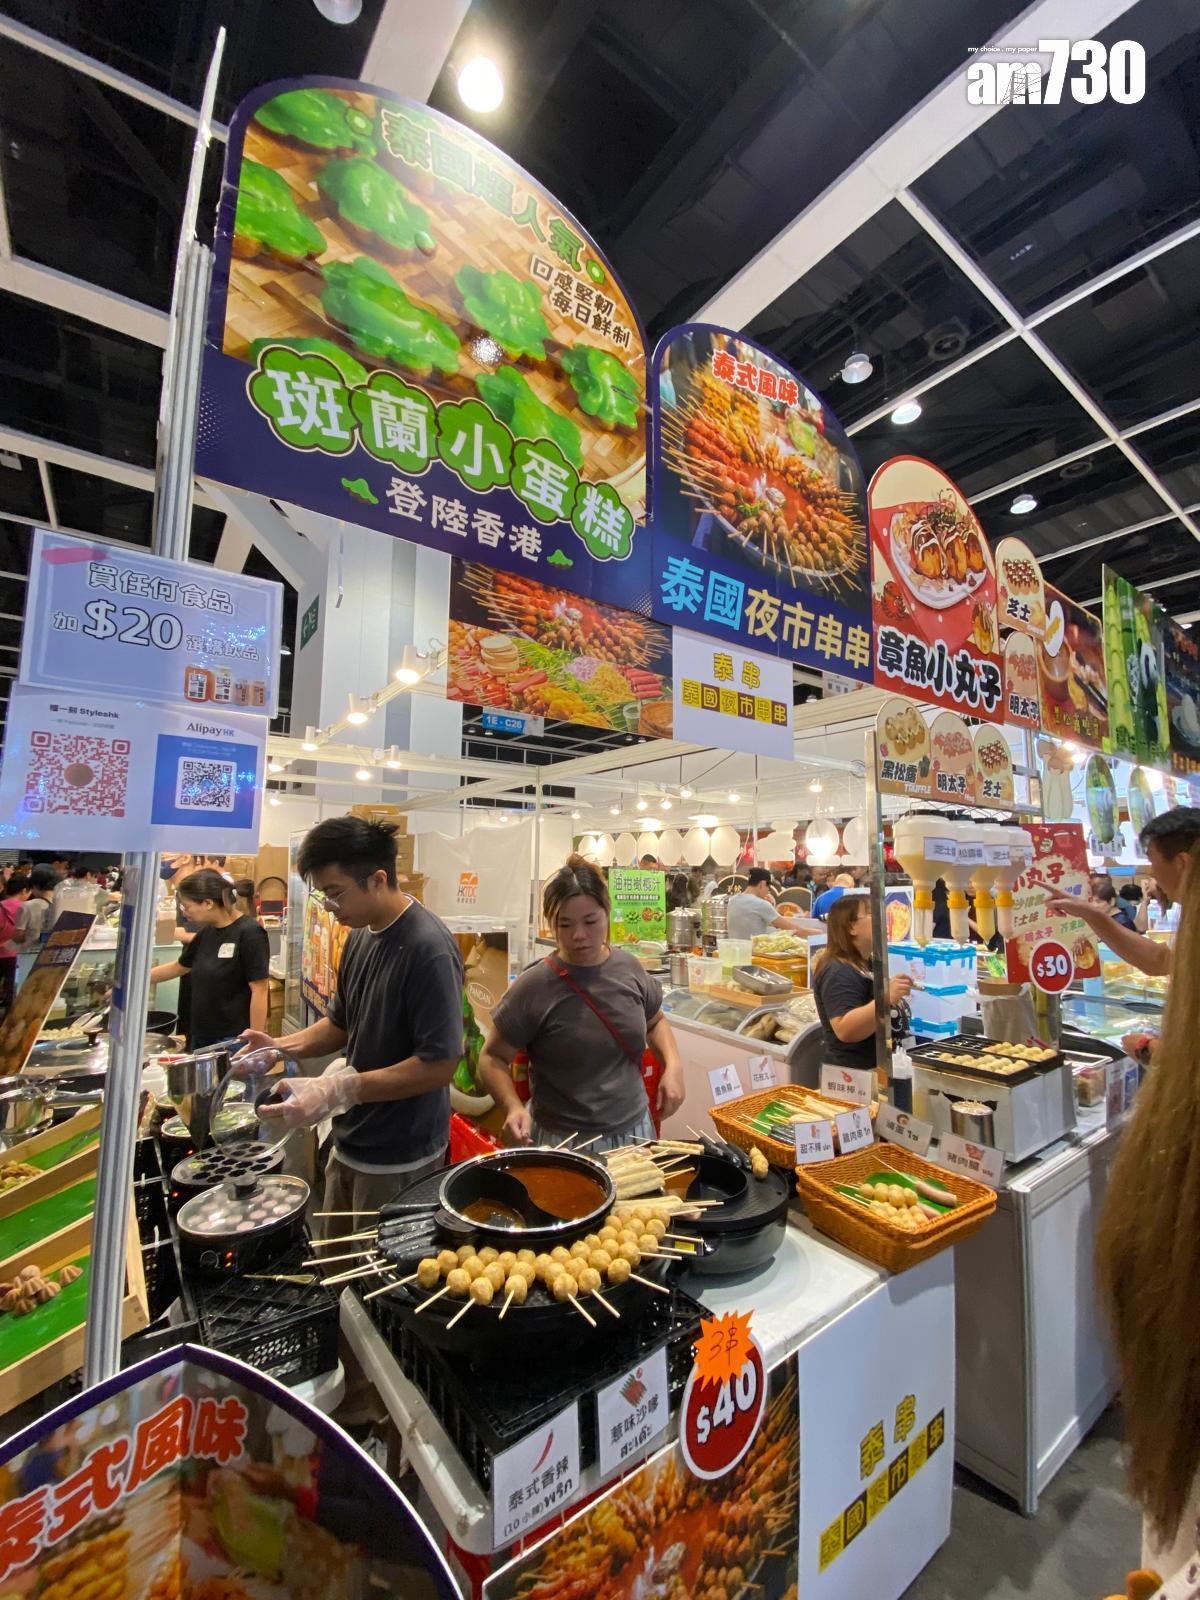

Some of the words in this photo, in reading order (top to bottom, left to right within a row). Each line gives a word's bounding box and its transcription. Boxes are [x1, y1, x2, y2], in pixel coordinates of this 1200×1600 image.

[552, 291, 631, 348] 每日鮮制
[711, 350, 799, 406] 泰式風味
[267, 369, 626, 551] 斑蘭小蛋糕
[386, 477, 543, 562] 登陸香港
[88, 563, 234, 615] 買任何食品
[660, 555, 871, 669] 泰國夜市串串
[1007, 598, 1031, 622] 芝士
[53, 611, 79, 632] 加
[83, 599, 183, 650] $20
[878, 630, 1002, 708] 章魚小丸子
[682, 680, 787, 727] 泰國夜市串串
[881, 760, 918, 783] 黑松露
[937, 773, 967, 793] 明太子
[983, 779, 1002, 798] 芝士
[1037, 954, 1069, 978] $30
[697, 1359, 757, 1443] $40
[508, 1455, 569, 1512] 泰式香辣
